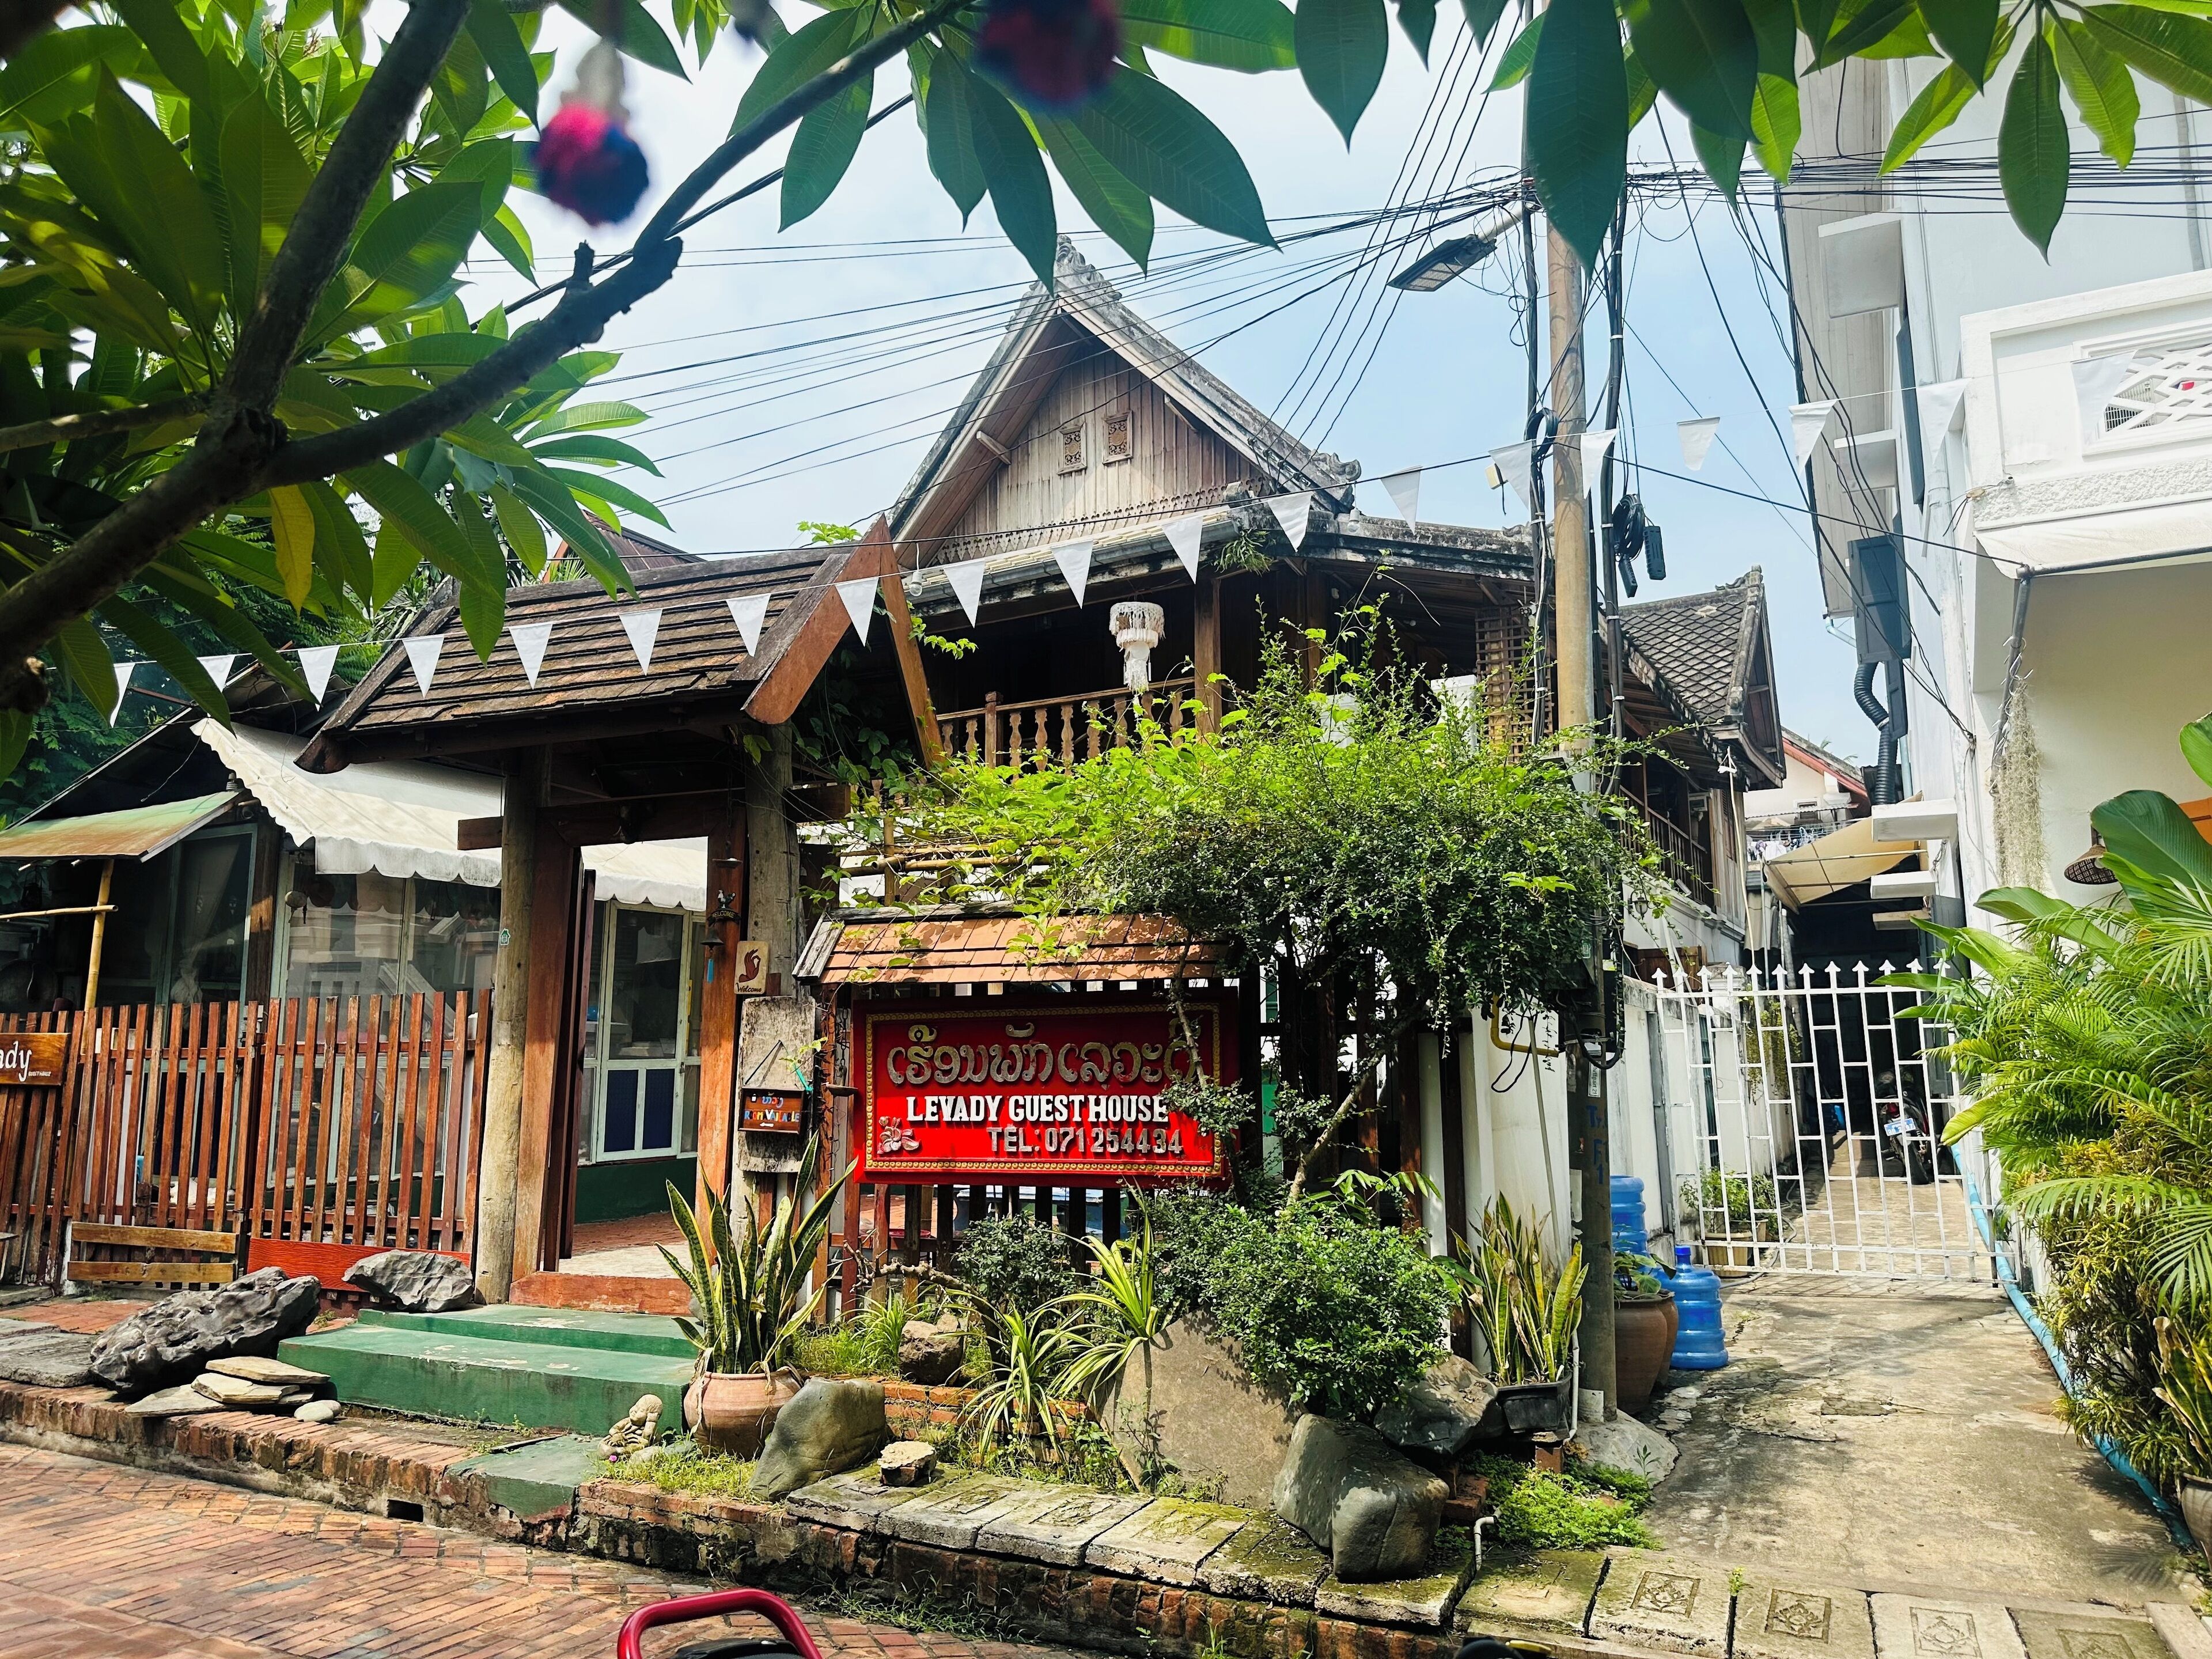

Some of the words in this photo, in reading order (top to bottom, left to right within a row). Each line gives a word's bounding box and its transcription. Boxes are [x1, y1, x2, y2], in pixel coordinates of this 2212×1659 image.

[736, 982, 762, 992] Welcome
[906, 1095, 1002, 1122] LEVADY
[986, 1127, 1039, 1152] TEL:
